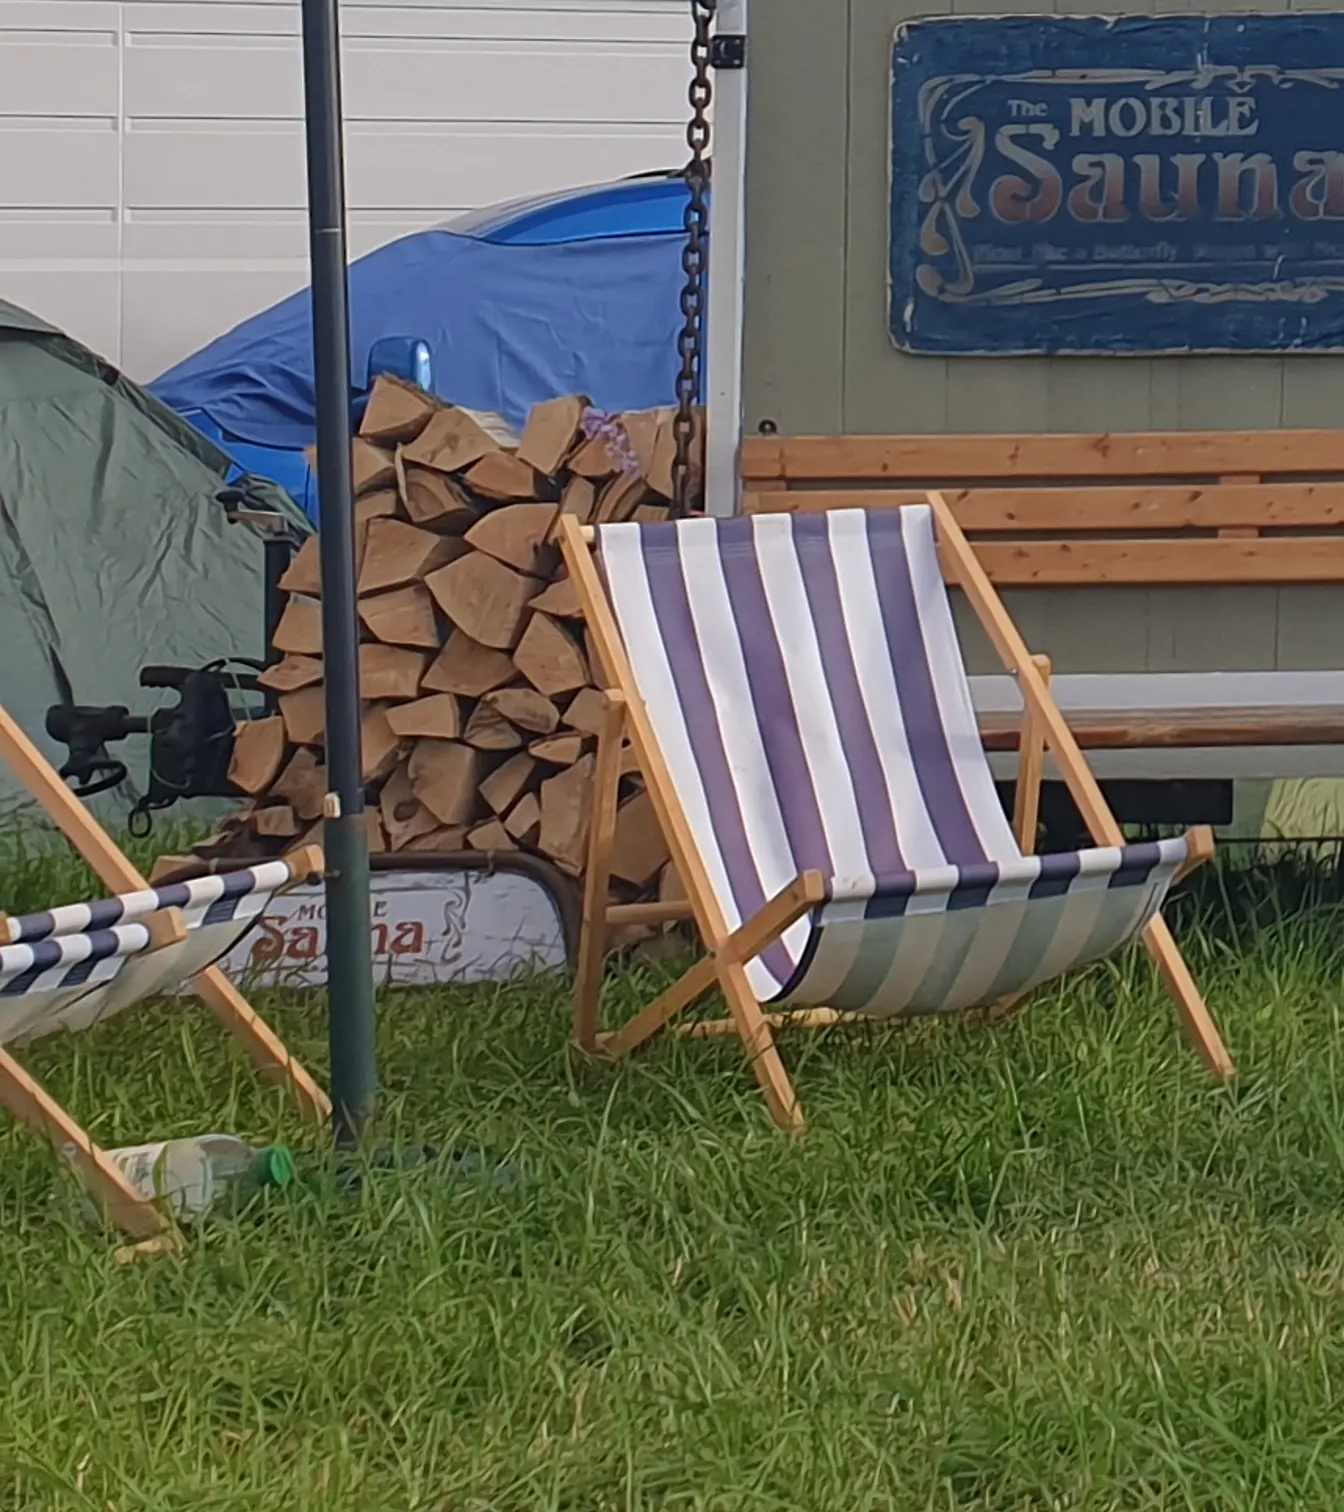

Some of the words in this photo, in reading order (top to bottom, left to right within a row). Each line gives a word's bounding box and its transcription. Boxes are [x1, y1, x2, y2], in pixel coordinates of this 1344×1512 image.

[1007, 99, 1048, 117] The
[1069, 95, 1260, 137] MOBILE
[252, 915, 424, 965] Sana
